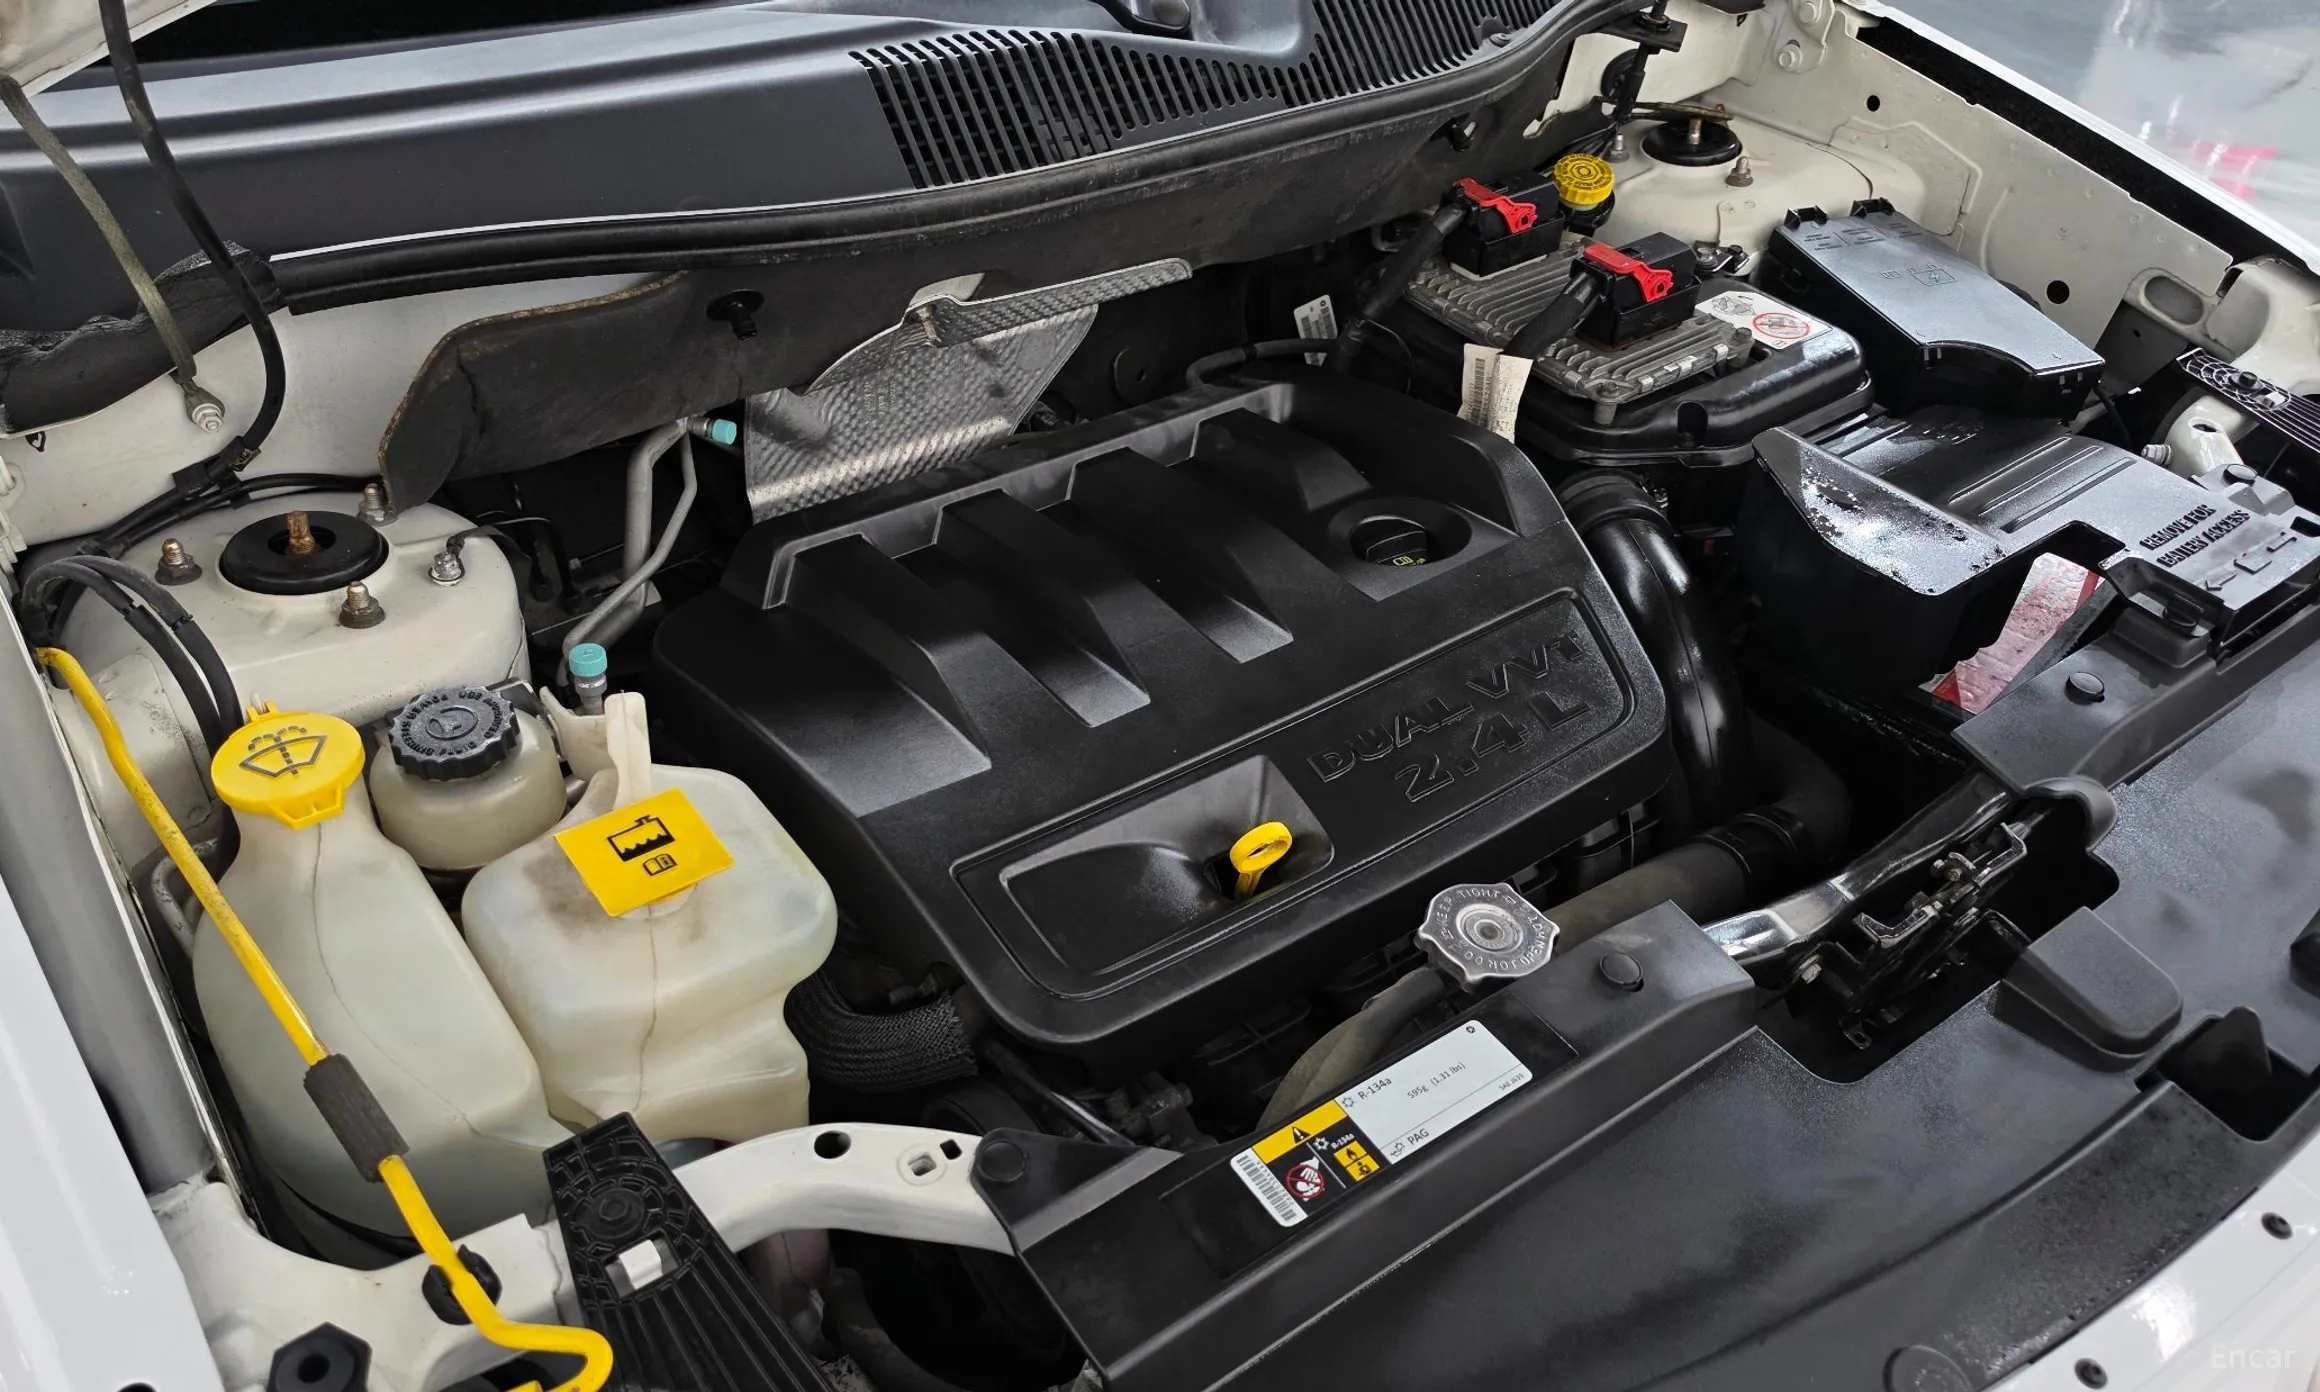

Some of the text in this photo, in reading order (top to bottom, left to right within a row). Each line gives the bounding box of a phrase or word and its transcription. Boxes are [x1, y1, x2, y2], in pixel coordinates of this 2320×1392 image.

[2139, 504, 2217, 551] REMOVE FOR
[2156, 509, 2251, 568] BATTERY ACCESS
[1306, 630, 1585, 783] DUAL VVT
[1457, 888, 1501, 900] TIGHT
[1357, 1077, 1393, 1101] R-134a
[1407, 1061, 1467, 1100] 595g (1.31 lbs)
[1407, 1128, 1430, 1146] PAG
